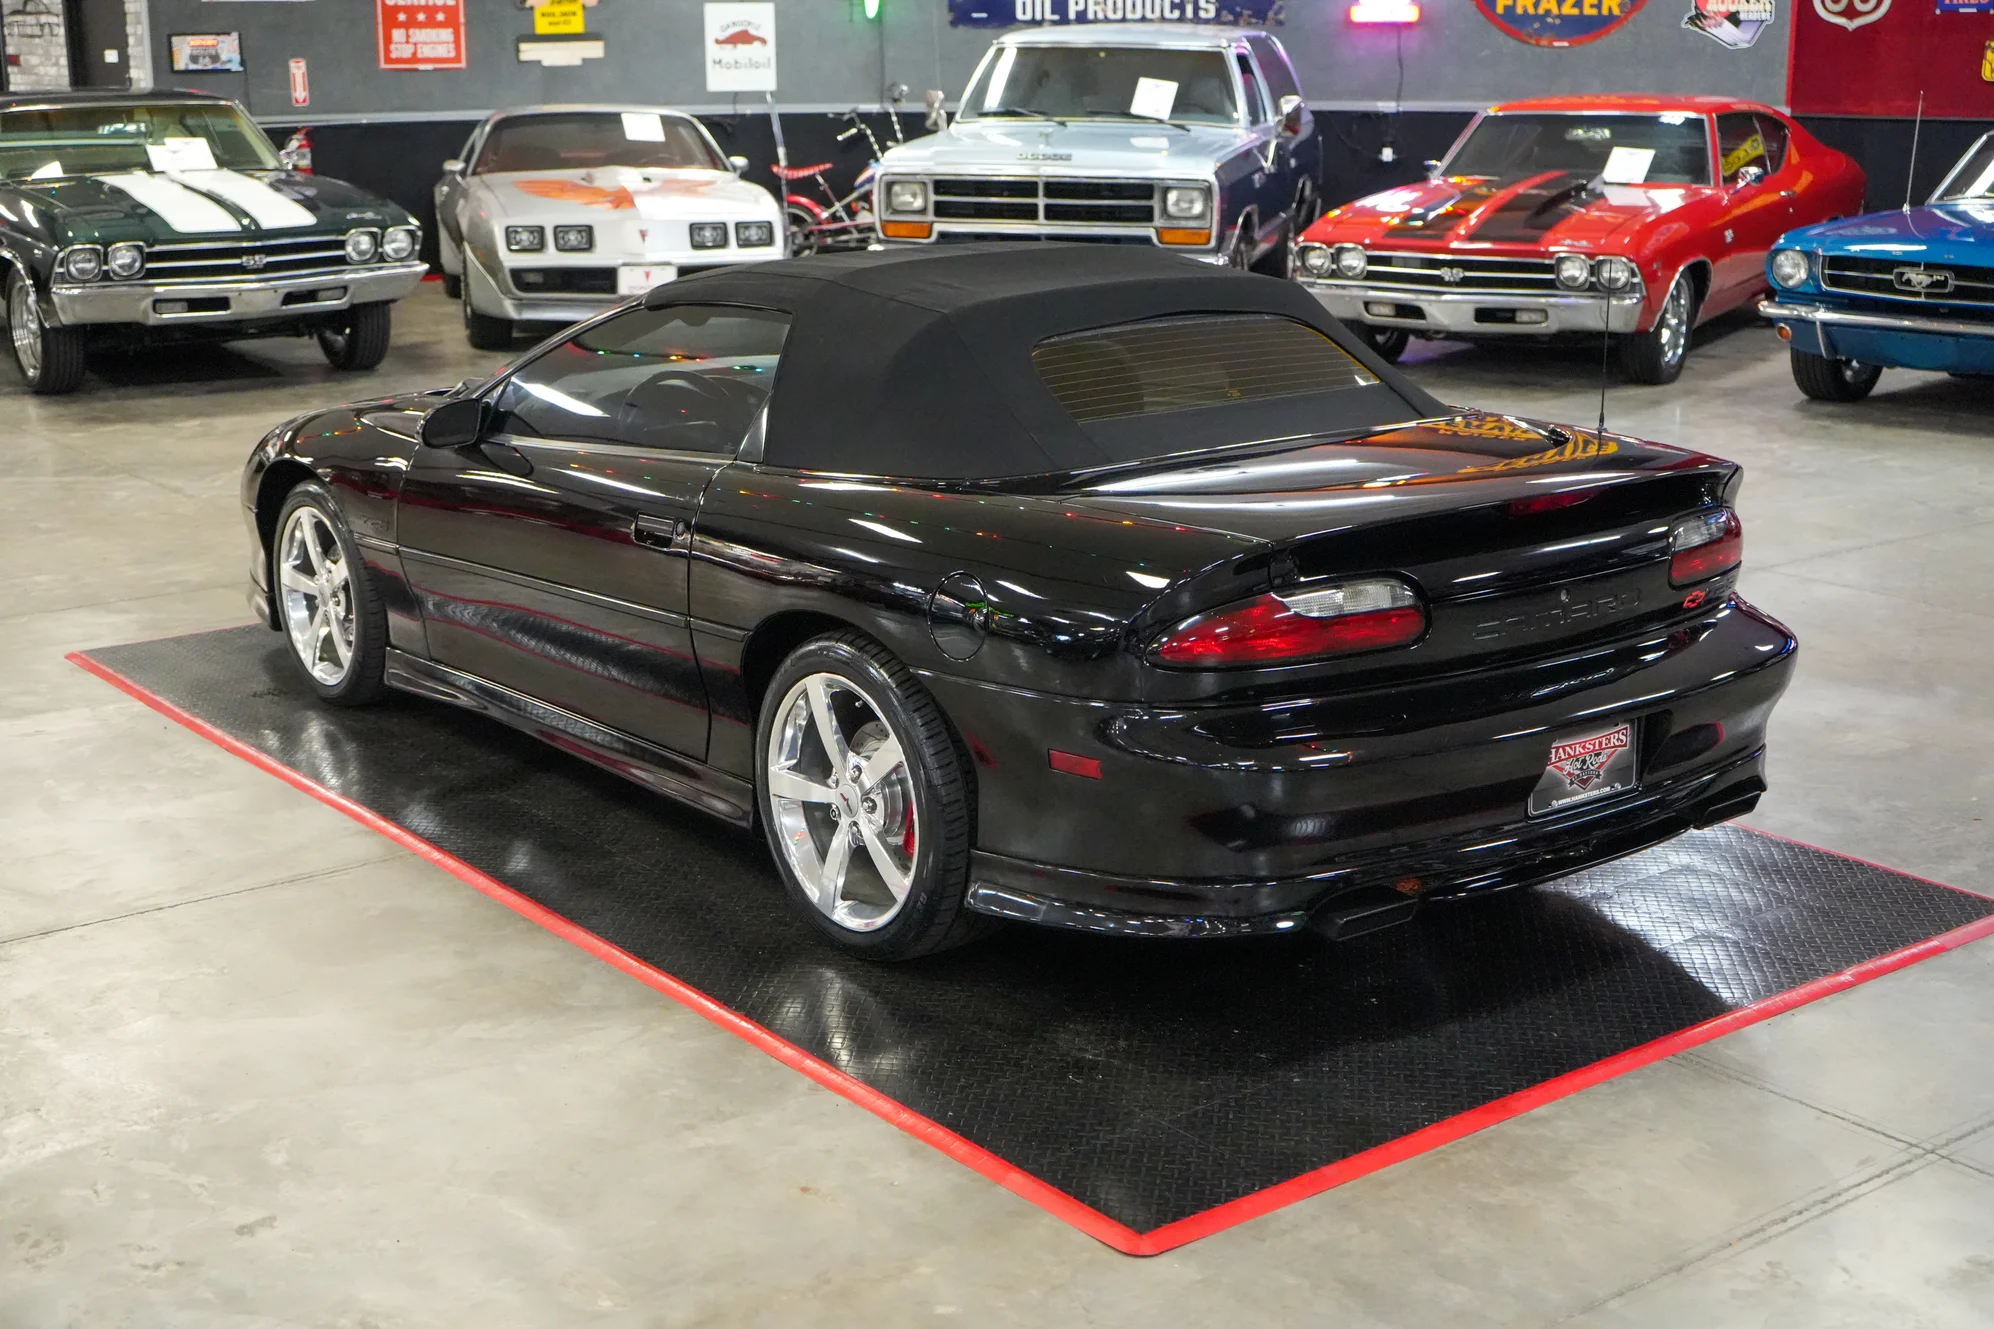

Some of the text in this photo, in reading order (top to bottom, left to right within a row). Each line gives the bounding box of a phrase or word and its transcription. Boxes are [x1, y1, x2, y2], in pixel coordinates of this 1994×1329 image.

[1015, 0, 1216, 21] OIL PRODUCTS
[1495, 0, 1622, 16] FRAZER
[391, 28, 455, 43] NO SMOKING
[389, 43, 456, 58] STOP ENGINES
[711, 57, 772, 70] Mobiloil
[1473, 587, 1642, 641] CAMARO
[1562, 756, 1585, 775] Hot
